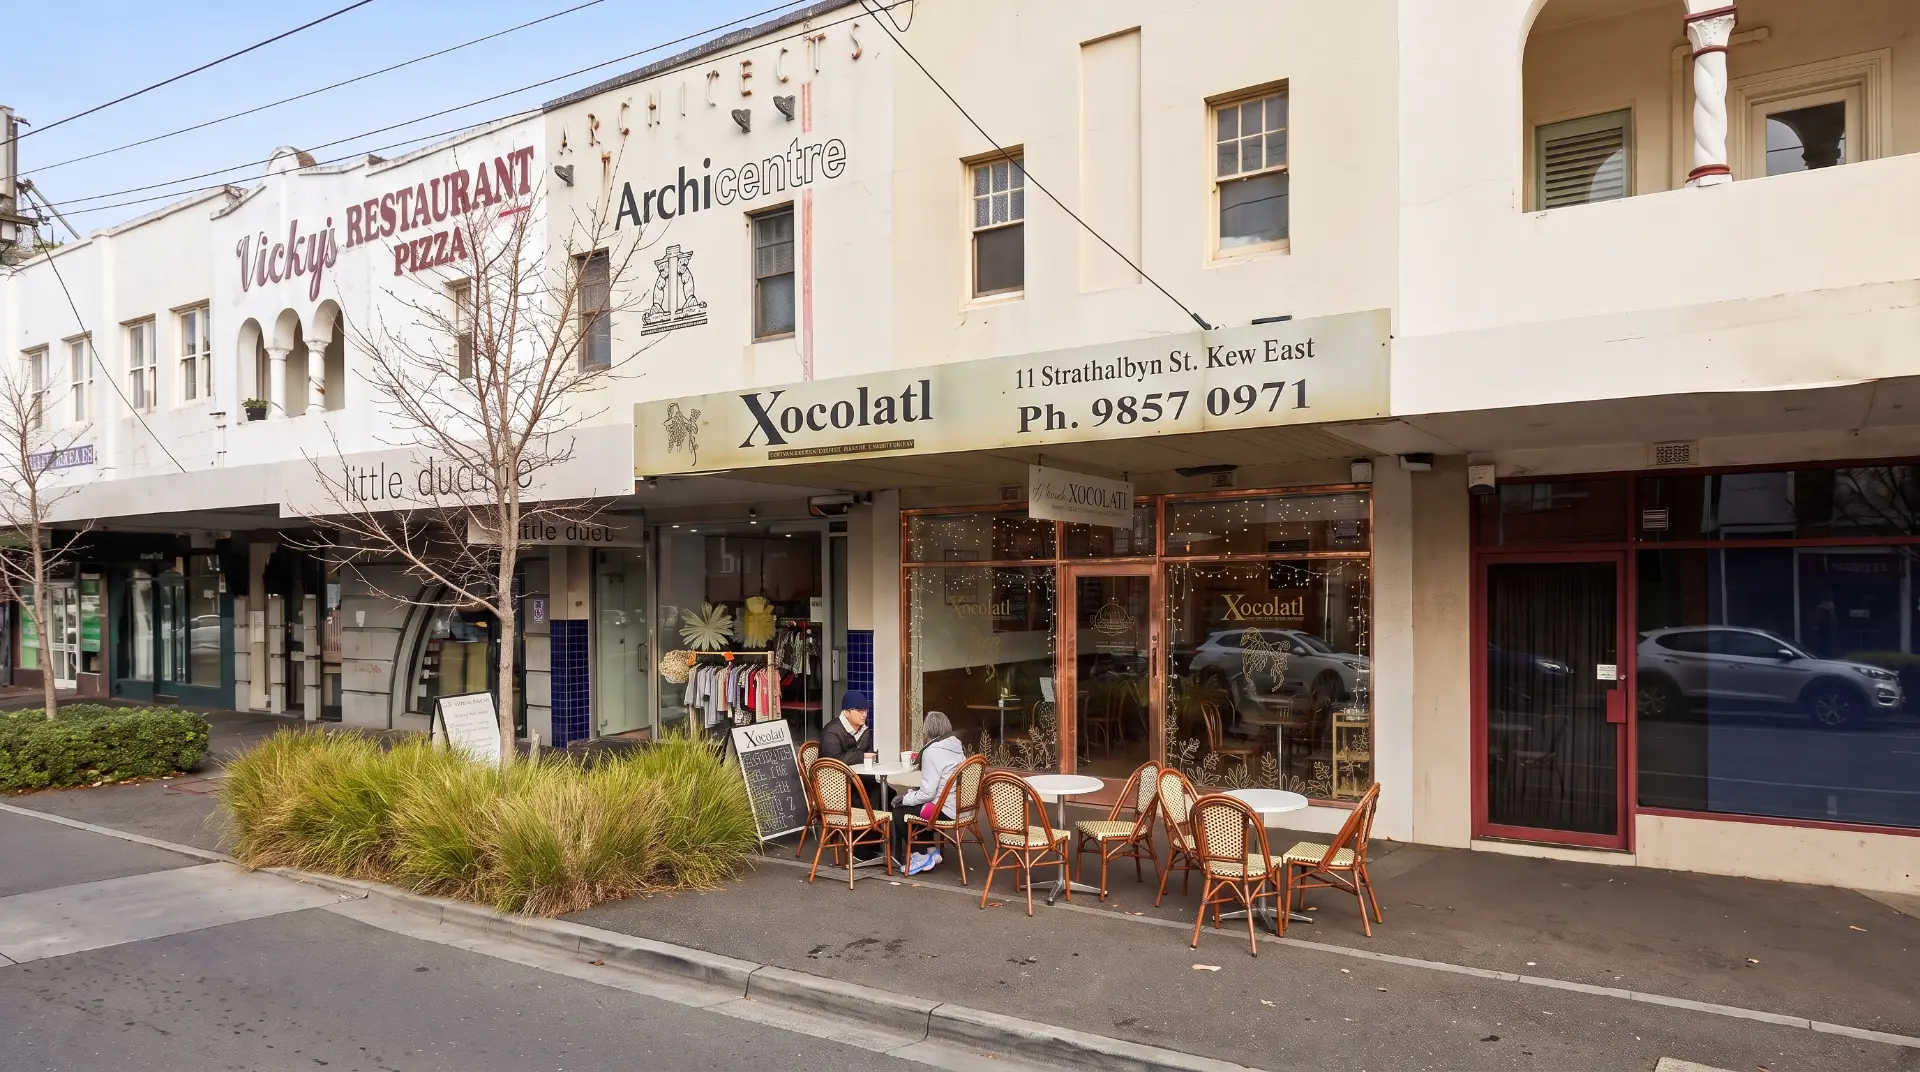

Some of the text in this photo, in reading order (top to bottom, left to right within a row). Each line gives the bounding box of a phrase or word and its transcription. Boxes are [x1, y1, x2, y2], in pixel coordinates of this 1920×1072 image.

[345, 145, 534, 248] RESTAURANT
[614, 137, 847, 231] Archicentre
[236, 216, 337, 302] Vicky's
[393, 226, 469, 277] PIZZA
[1015, 337, 1316, 389] 11 Strathalbyn St. Kew East
[738, 379, 934, 449] Xocolatl
[1017, 378, 1311, 434] Ph. 9857 0971
[345, 461, 403, 503] little
[949, 595, 1011, 620] Xocolatl
[1219, 593, 1305, 621] Xocolatl
